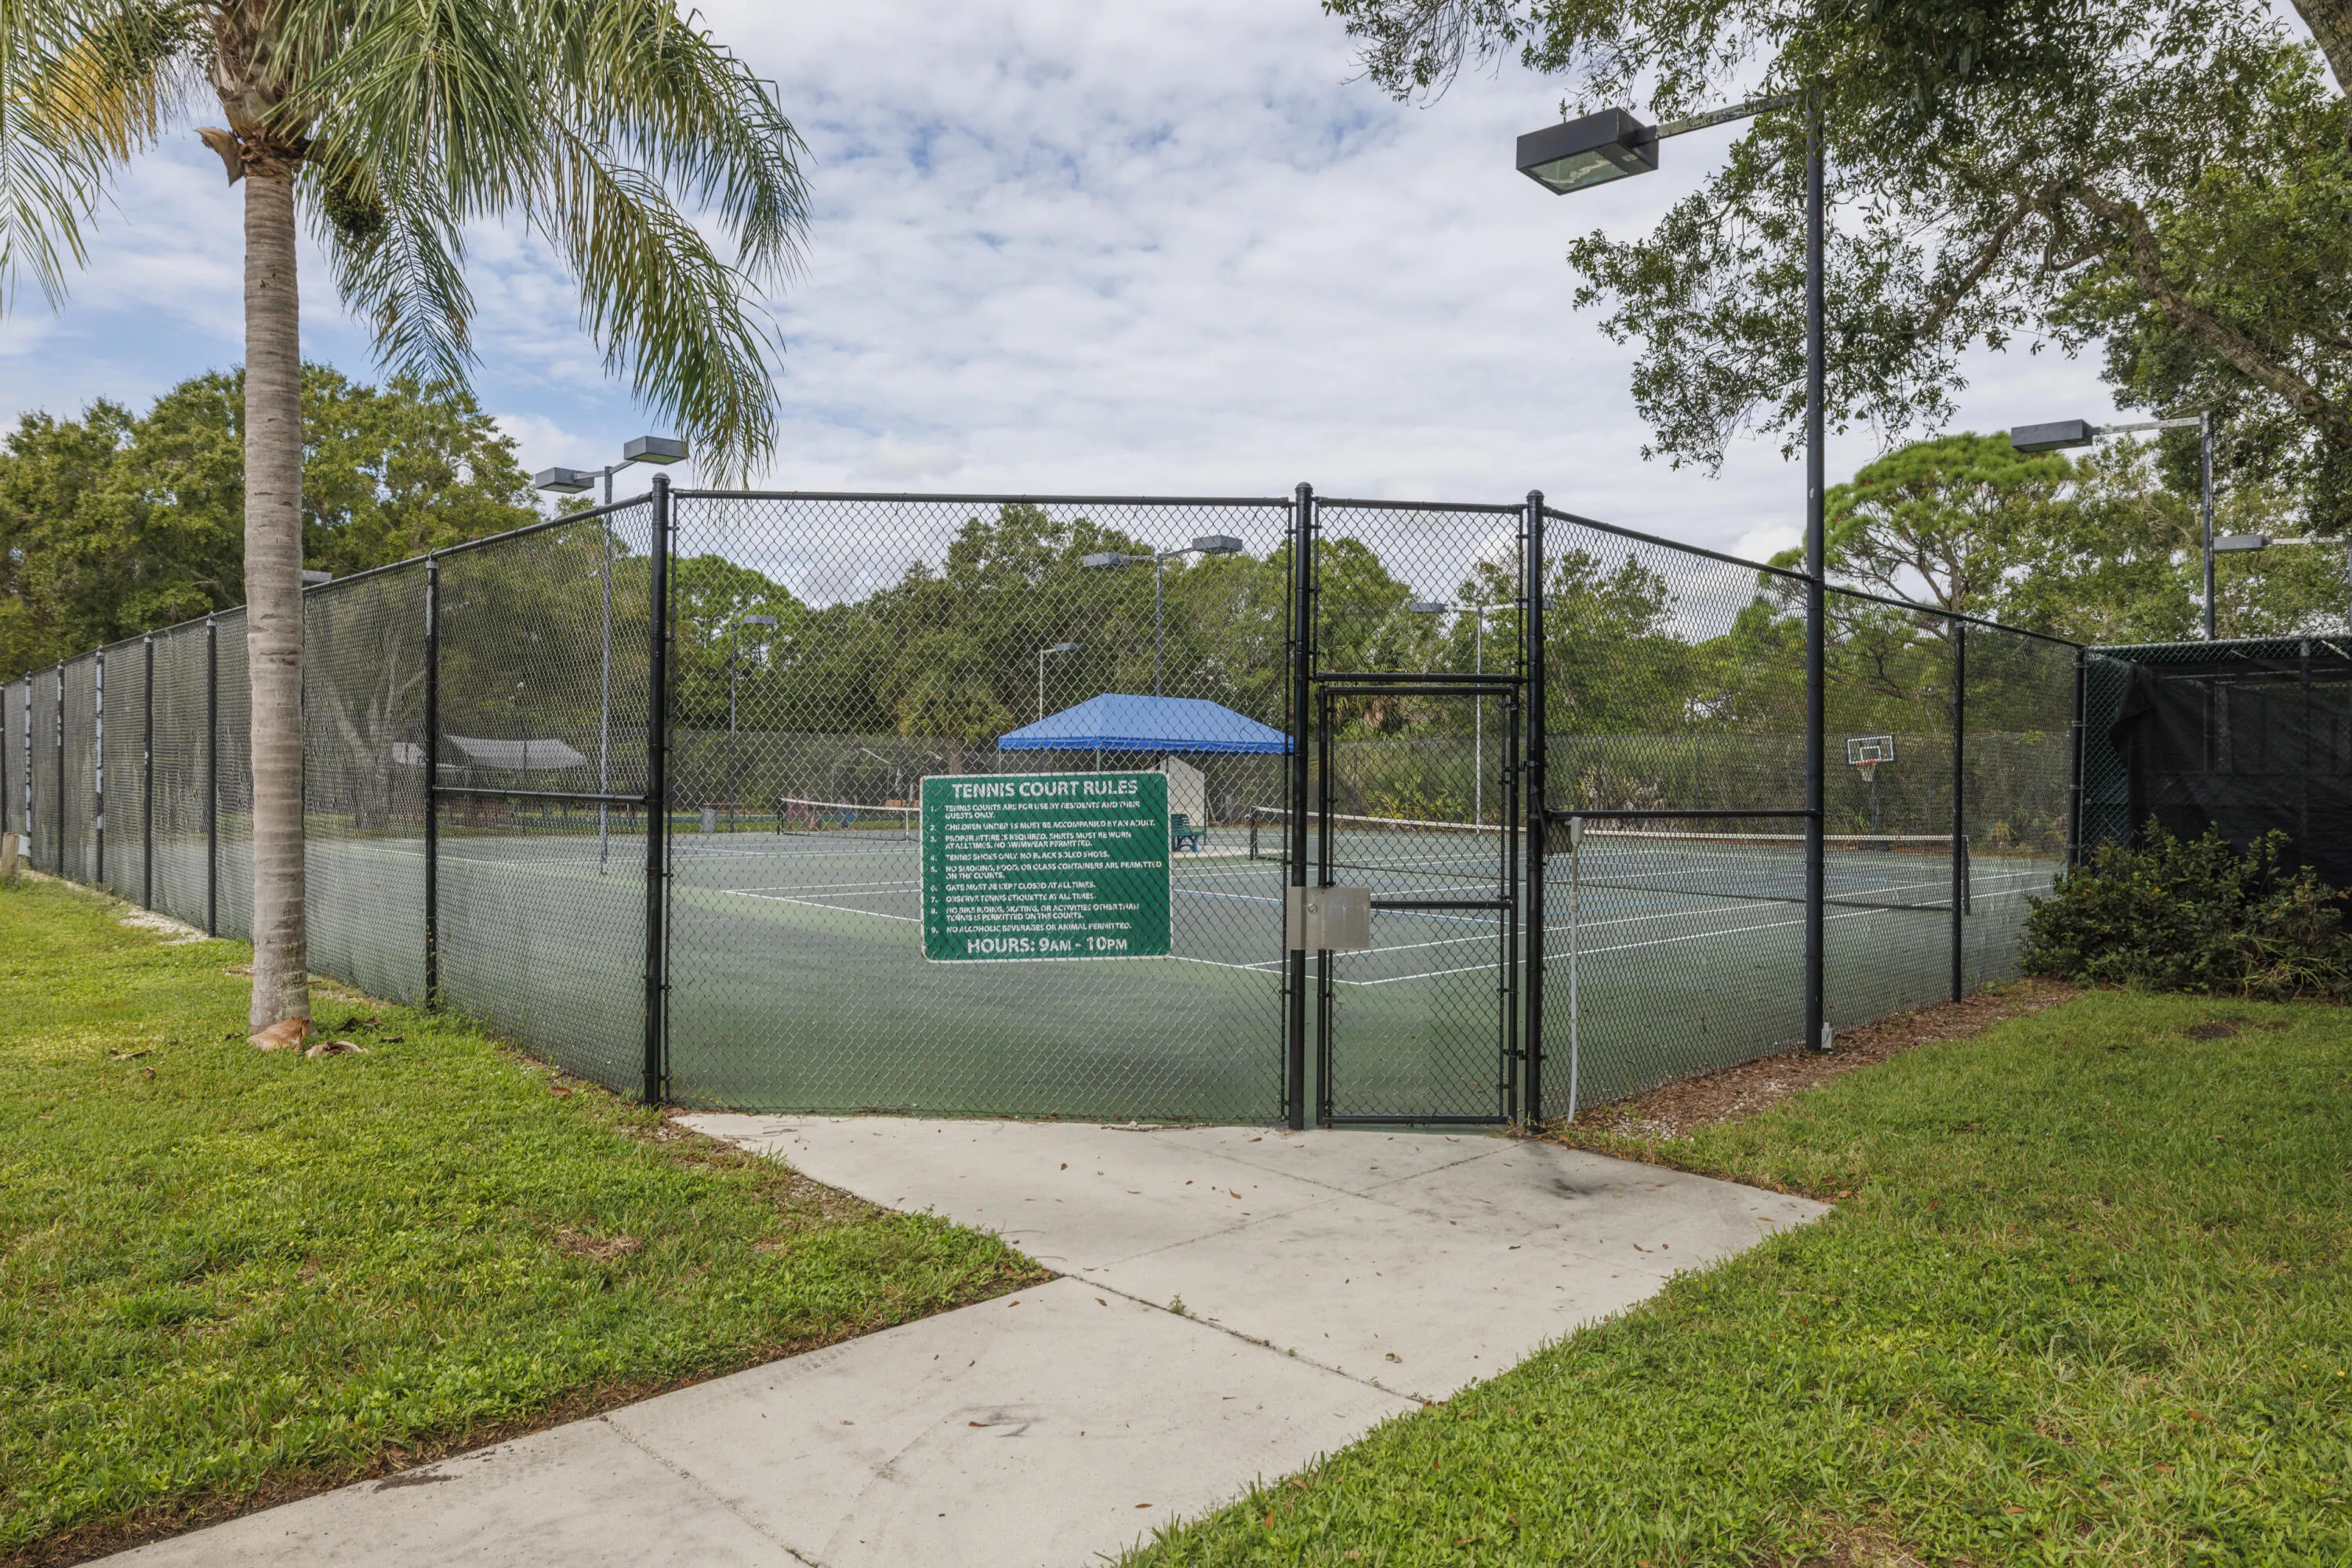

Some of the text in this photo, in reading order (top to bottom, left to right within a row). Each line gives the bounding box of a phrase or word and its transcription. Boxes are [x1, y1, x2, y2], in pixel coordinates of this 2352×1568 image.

[952, 780, 1138, 797] TENNIS COURT RULES
[959, 924, 1000, 933] ALCOHOLIC
[967, 938, 1035, 953] HOURS:
[1039, 937, 1071, 953] 9AM
[1087, 936, 1127, 951] 10PM
